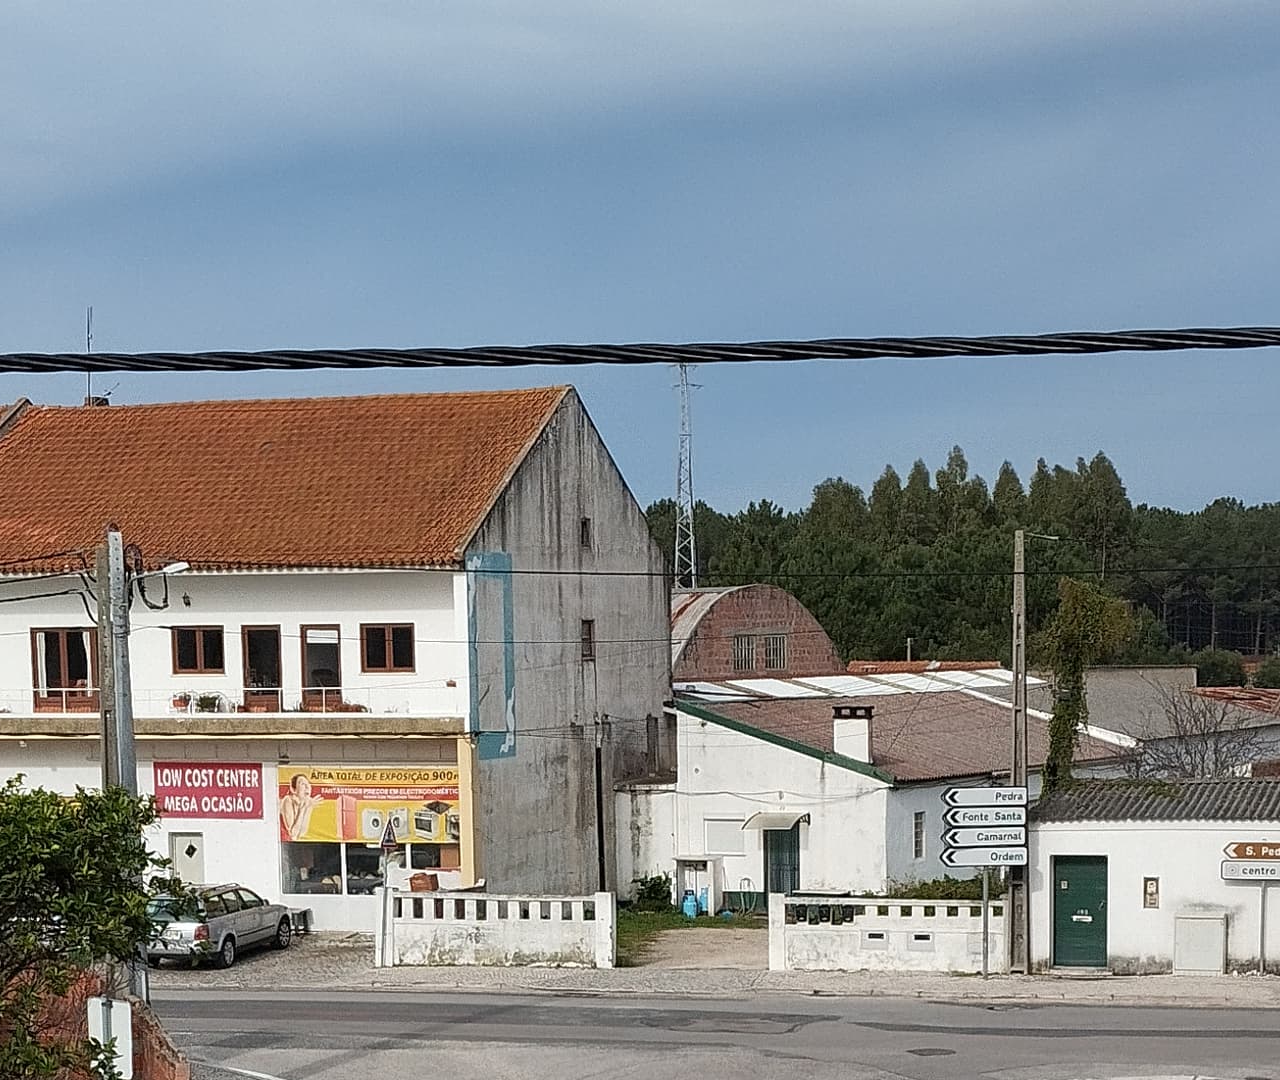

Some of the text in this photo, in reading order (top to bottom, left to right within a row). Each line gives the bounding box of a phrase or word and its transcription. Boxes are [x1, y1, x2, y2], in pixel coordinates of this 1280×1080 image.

[157, 768, 259, 788] LOW COST CENTER
[336, 771, 362, 781] TOTAL
[365, 772, 377, 781] DE
[379, 771, 430, 783] EXPOSIÇÃO
[995, 792, 1024, 801] Pedra
[164, 792, 253, 813] MEGA OCASIÃO
[962, 811, 1022, 821] Fonte Santa
[976, 831, 1022, 841] Camarnal
[1245, 846, 1257, 856] S.
[990, 852, 1024, 861] Ordem
[1242, 866, 1277, 875] centro
